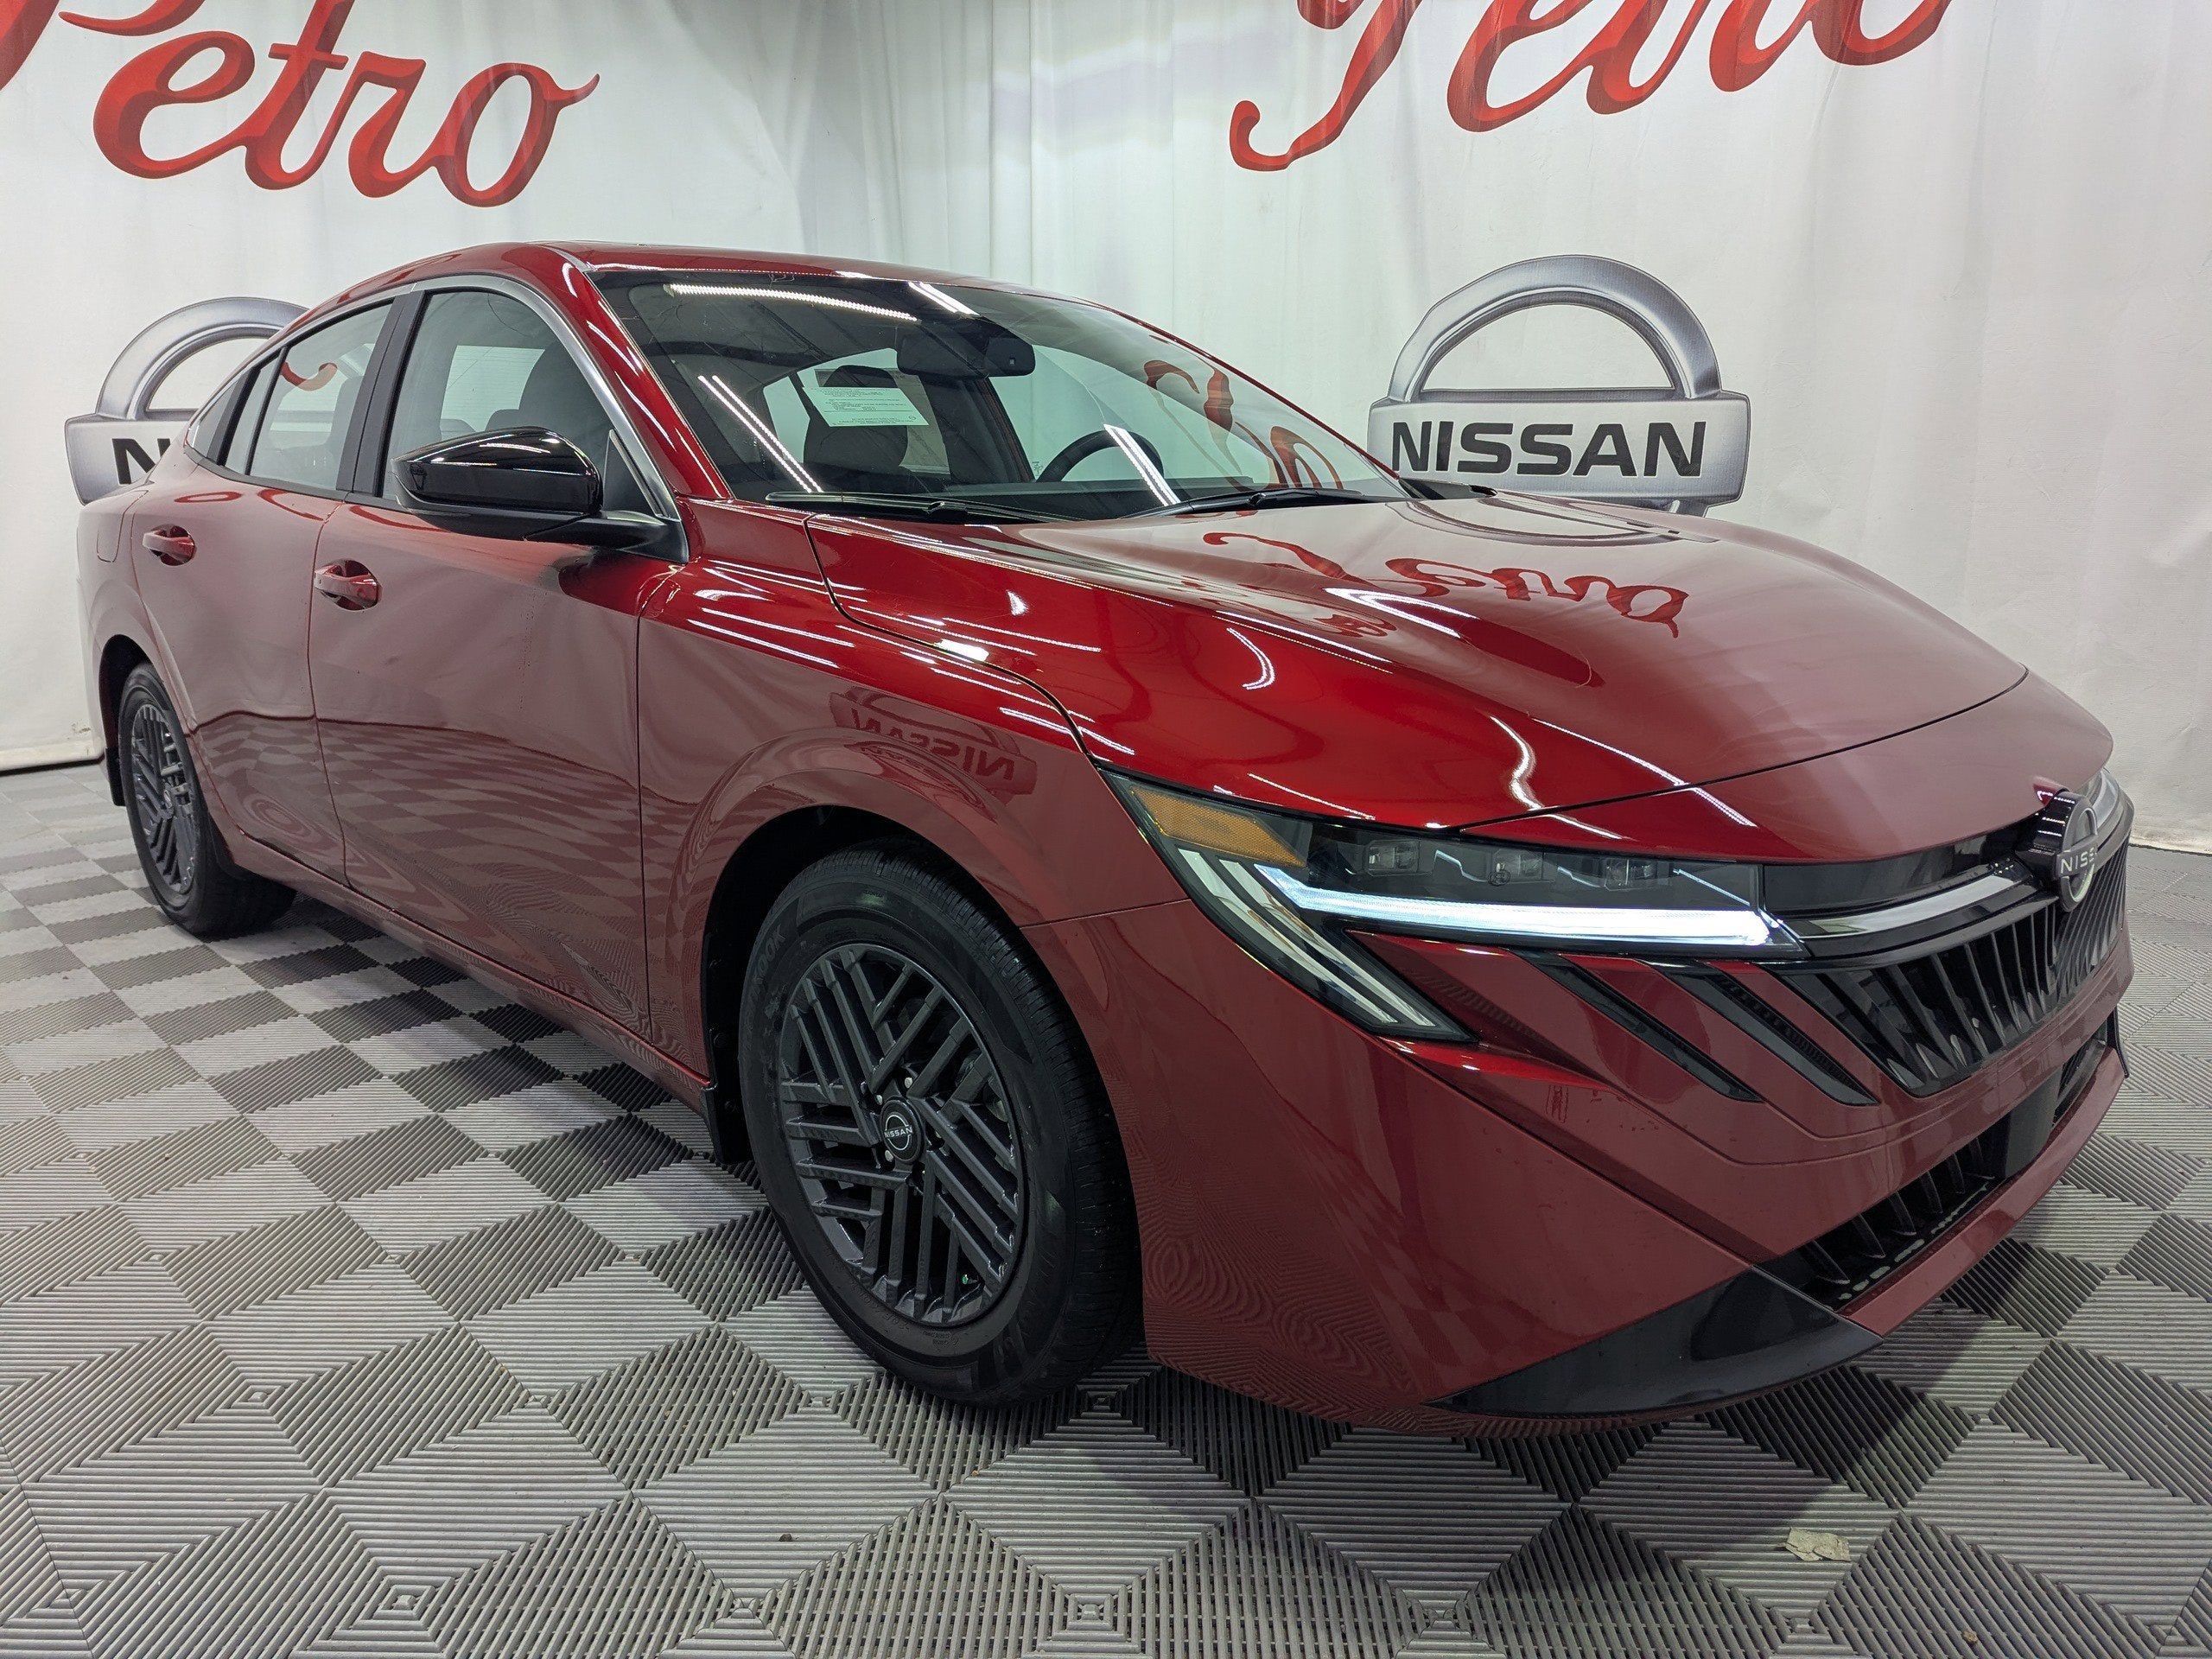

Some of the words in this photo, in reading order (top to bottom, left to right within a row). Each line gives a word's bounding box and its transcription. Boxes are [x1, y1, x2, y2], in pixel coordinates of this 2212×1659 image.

[1391, 421, 1707, 478] NISSAN
[2060, 847, 2097, 874] NISS
[884, 1126, 913, 1138] NISSAN
